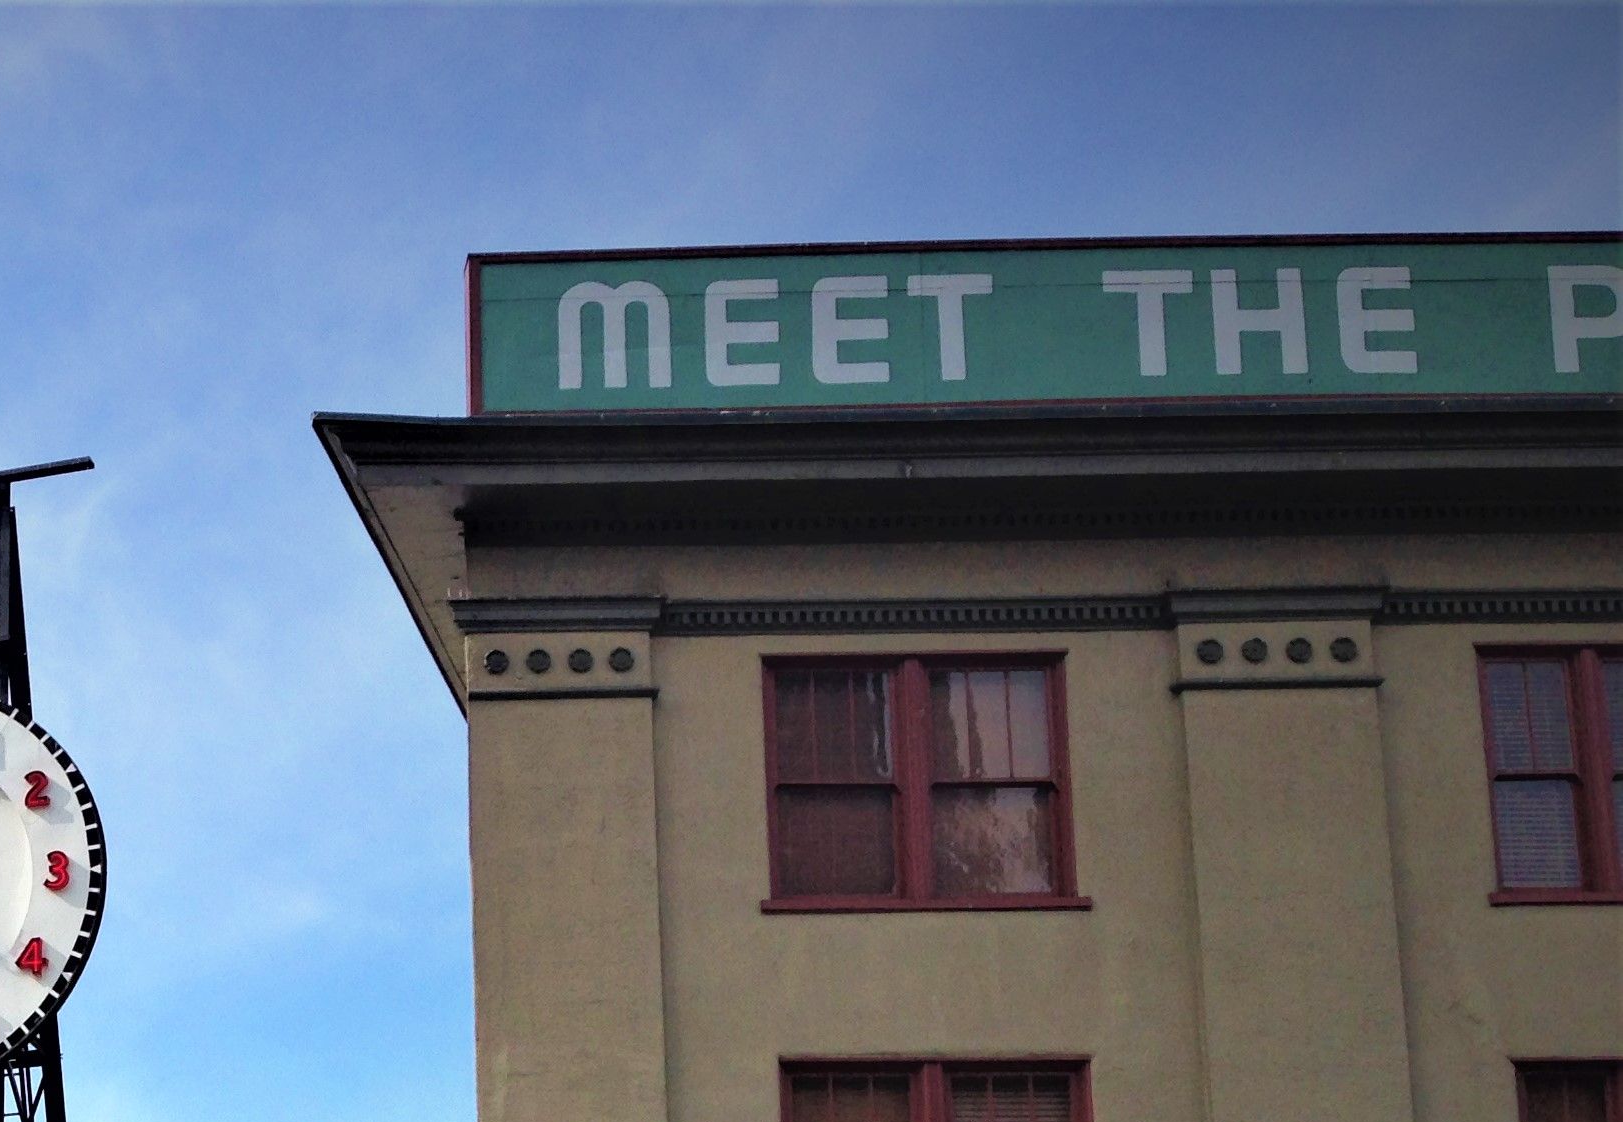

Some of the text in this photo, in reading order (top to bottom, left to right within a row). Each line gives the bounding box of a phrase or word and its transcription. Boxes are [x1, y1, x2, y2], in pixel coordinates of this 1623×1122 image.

[559, 274, 993, 390] MEET
[1102, 267, 1418, 376] THE
[25, 771, 50, 809] 2
[44, 851, 70, 891] 3
[15, 937, 49, 977] 4
